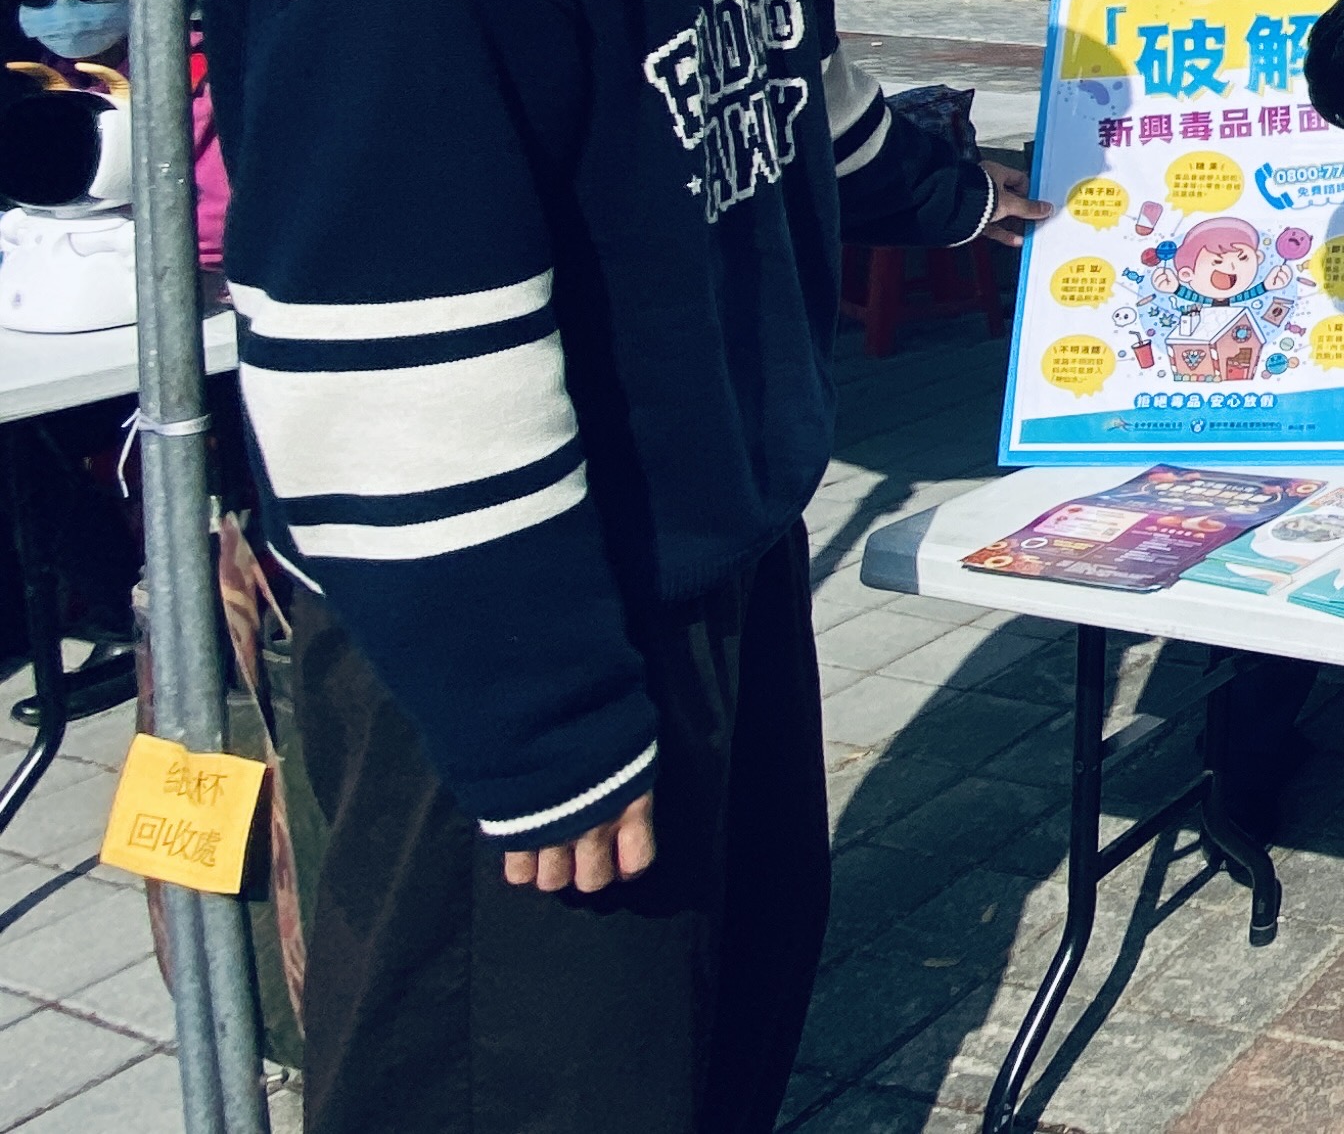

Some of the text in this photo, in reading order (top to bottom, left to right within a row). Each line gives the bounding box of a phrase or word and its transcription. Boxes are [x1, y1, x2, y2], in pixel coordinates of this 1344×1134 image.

[1098, 104, 1329, 149] 新興毒品假面
[1209, 394, 1275, 409] 安心放假
